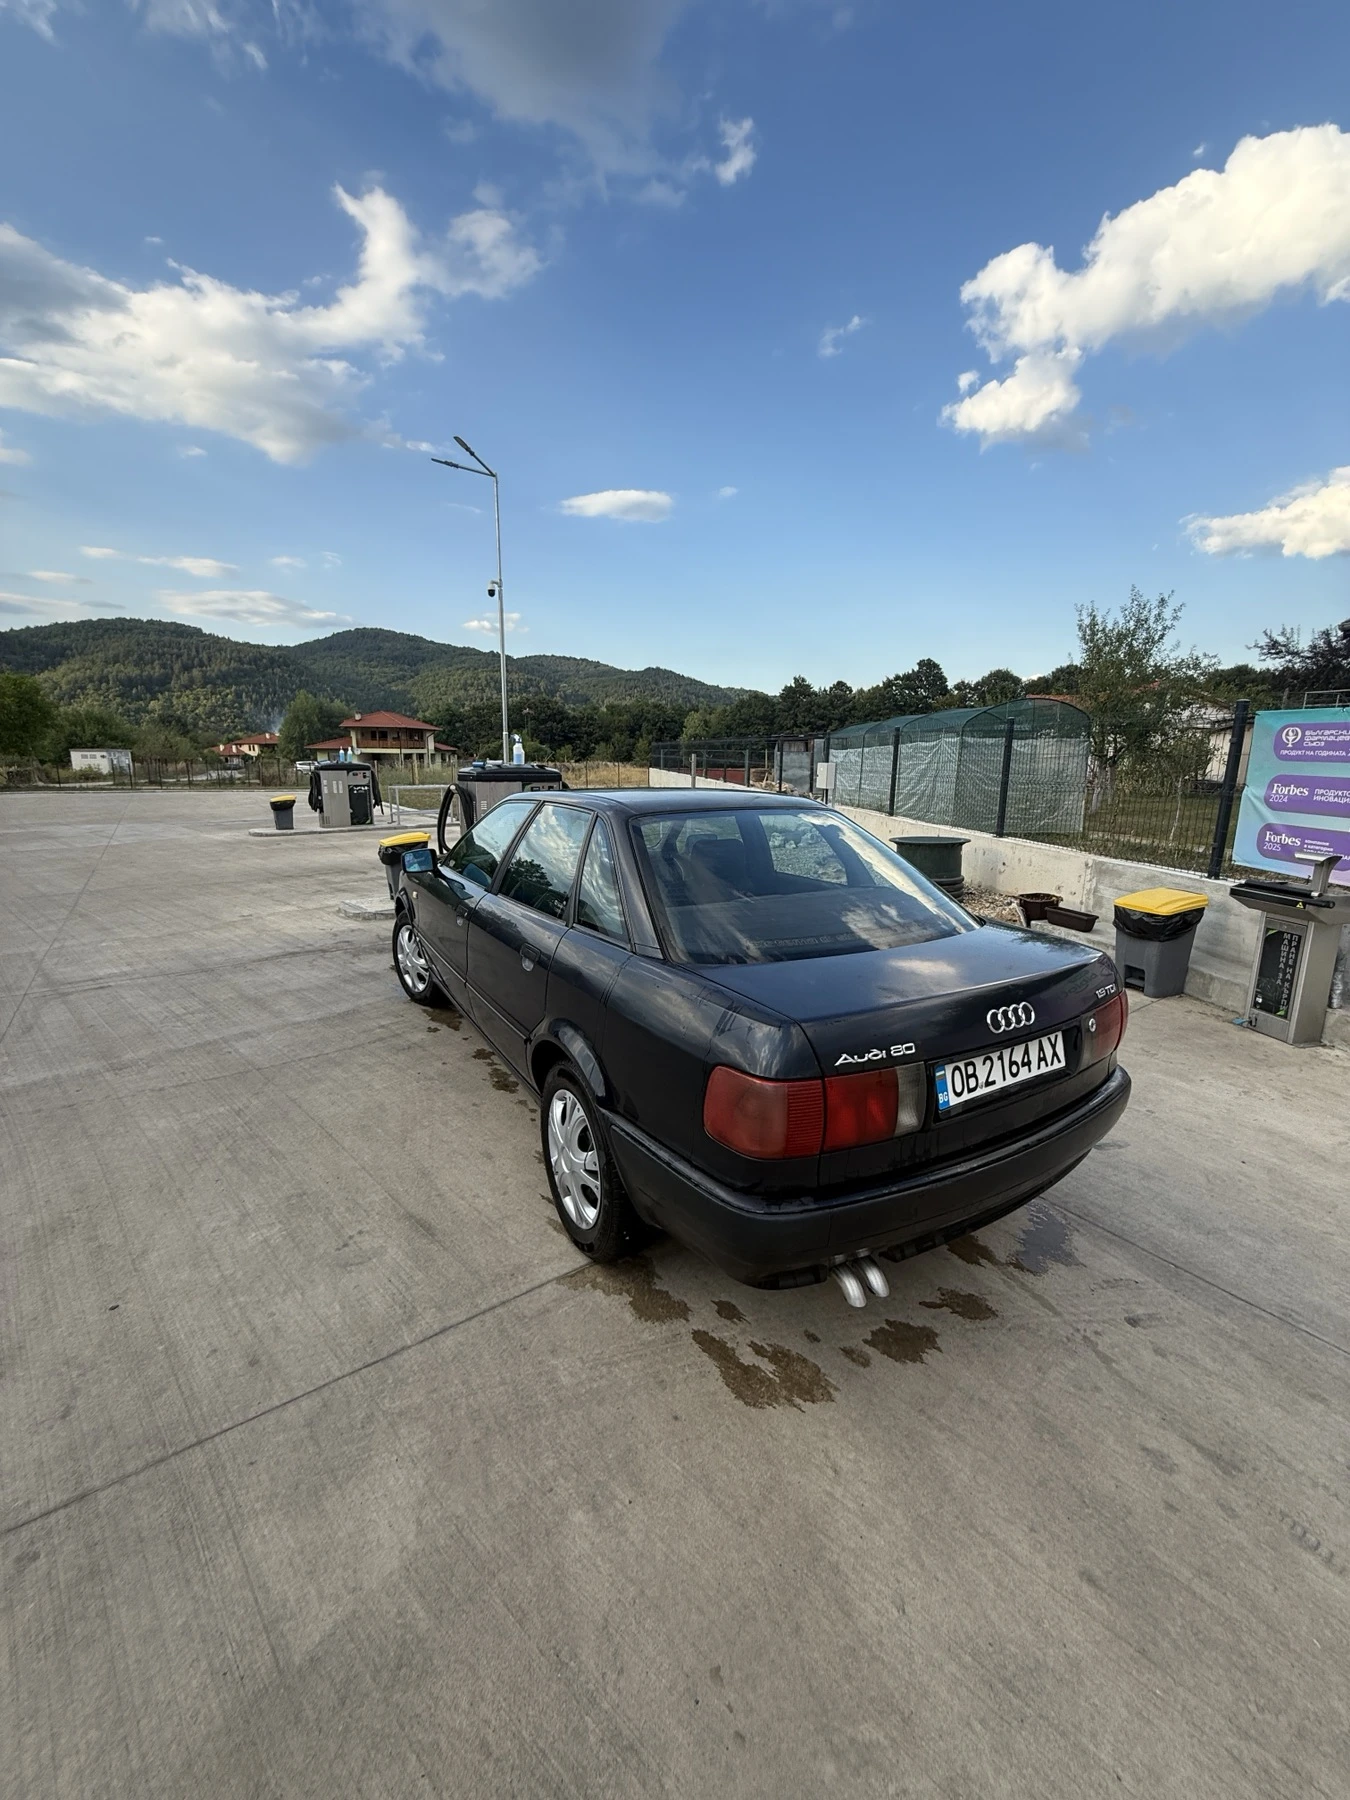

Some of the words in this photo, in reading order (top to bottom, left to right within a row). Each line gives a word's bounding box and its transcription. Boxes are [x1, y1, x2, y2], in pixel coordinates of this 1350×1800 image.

[1272, 783, 1309, 796] Forbes
[1269, 794, 1288, 803] 2024
[1313, 795, 1350, 804] ИНОВАЦИ
[1265, 831, 1301, 846] Forbes
[1263, 842, 1281, 851] 2025
[1279, 933, 1291, 969] МАШИНА
[1289, 935, 1298, 965] ПРАНЕ
[1276, 973, 1283, 985] ЗА
[1286, 967, 1293, 979] НА
[834, 1048, 887, 1066] Audi
[890, 1043, 916, 1057] 80
[1037, 1034, 1062, 1071] AX
[938, 1094, 949, 1103] BG
